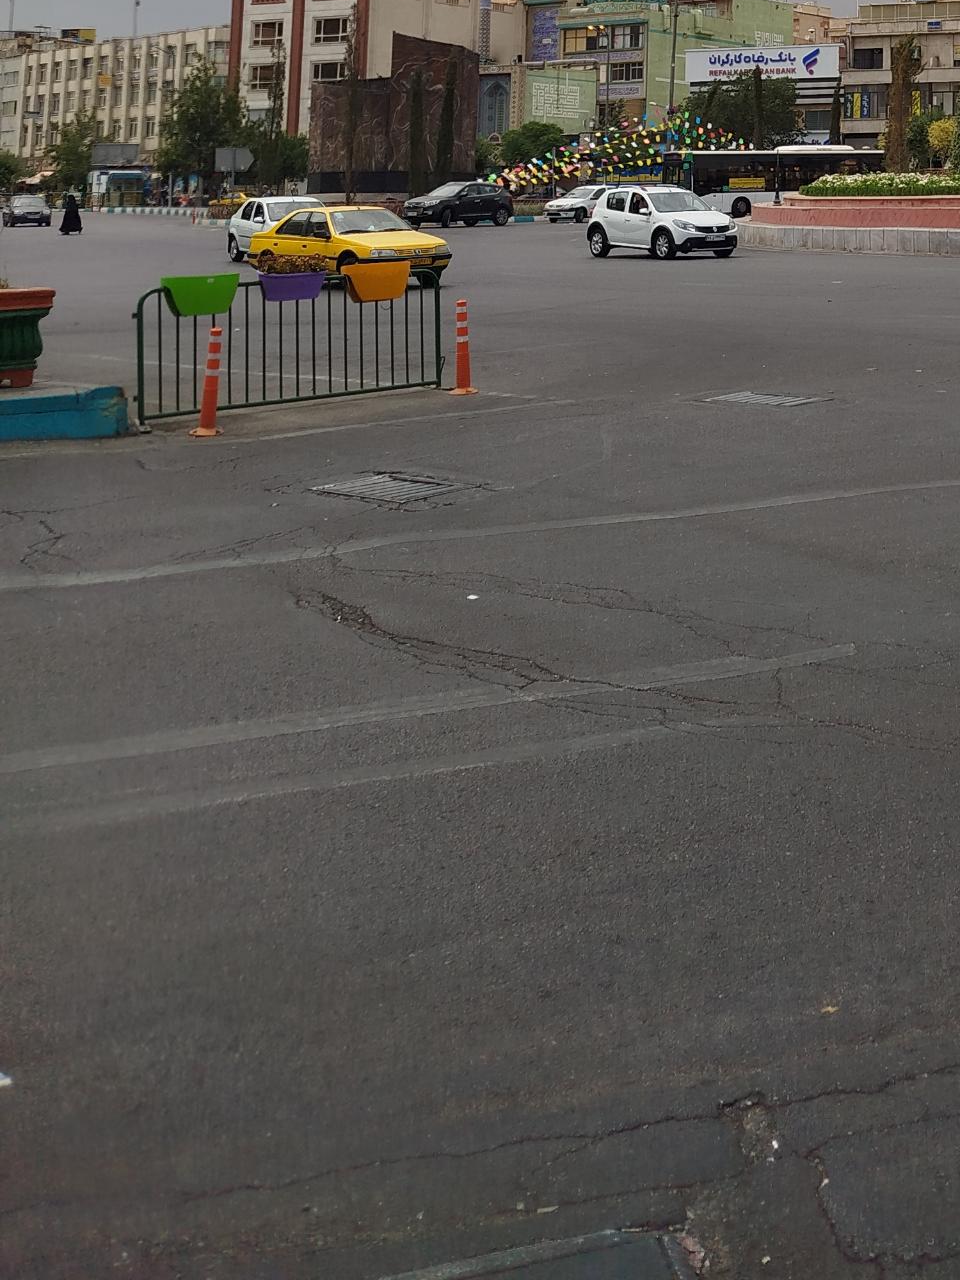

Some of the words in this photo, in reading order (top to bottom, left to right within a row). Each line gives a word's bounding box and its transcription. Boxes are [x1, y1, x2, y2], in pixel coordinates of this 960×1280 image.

[709, 53, 742, 67] کارگران
[743, 52, 769, 65] رفاه
[770, 51, 796, 65] بانک
[775, 67, 796, 75] BANK
